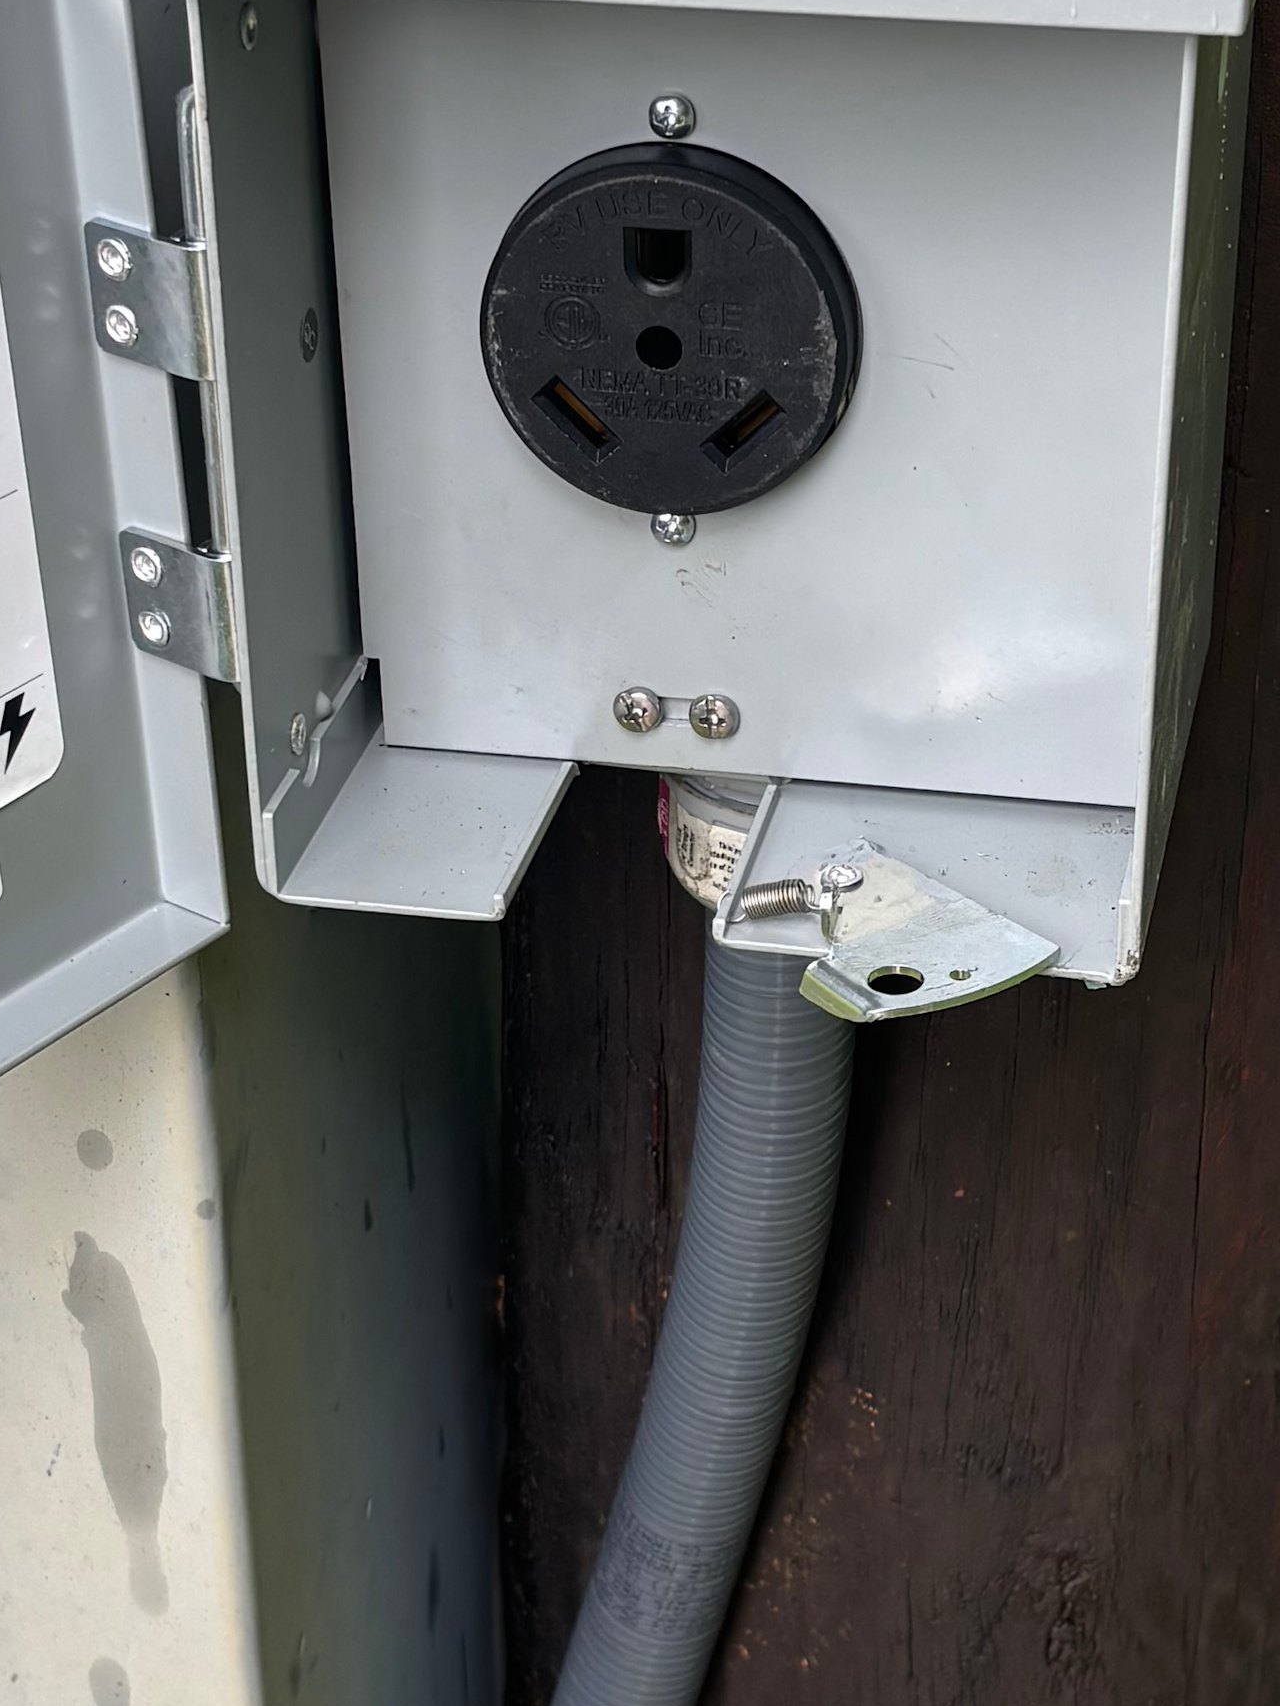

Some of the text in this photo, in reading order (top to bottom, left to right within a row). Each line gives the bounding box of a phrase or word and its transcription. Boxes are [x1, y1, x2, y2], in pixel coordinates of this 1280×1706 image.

[543, 191, 775, 259] RV USE ONLY
[581, 368, 646, 396] NEMA
